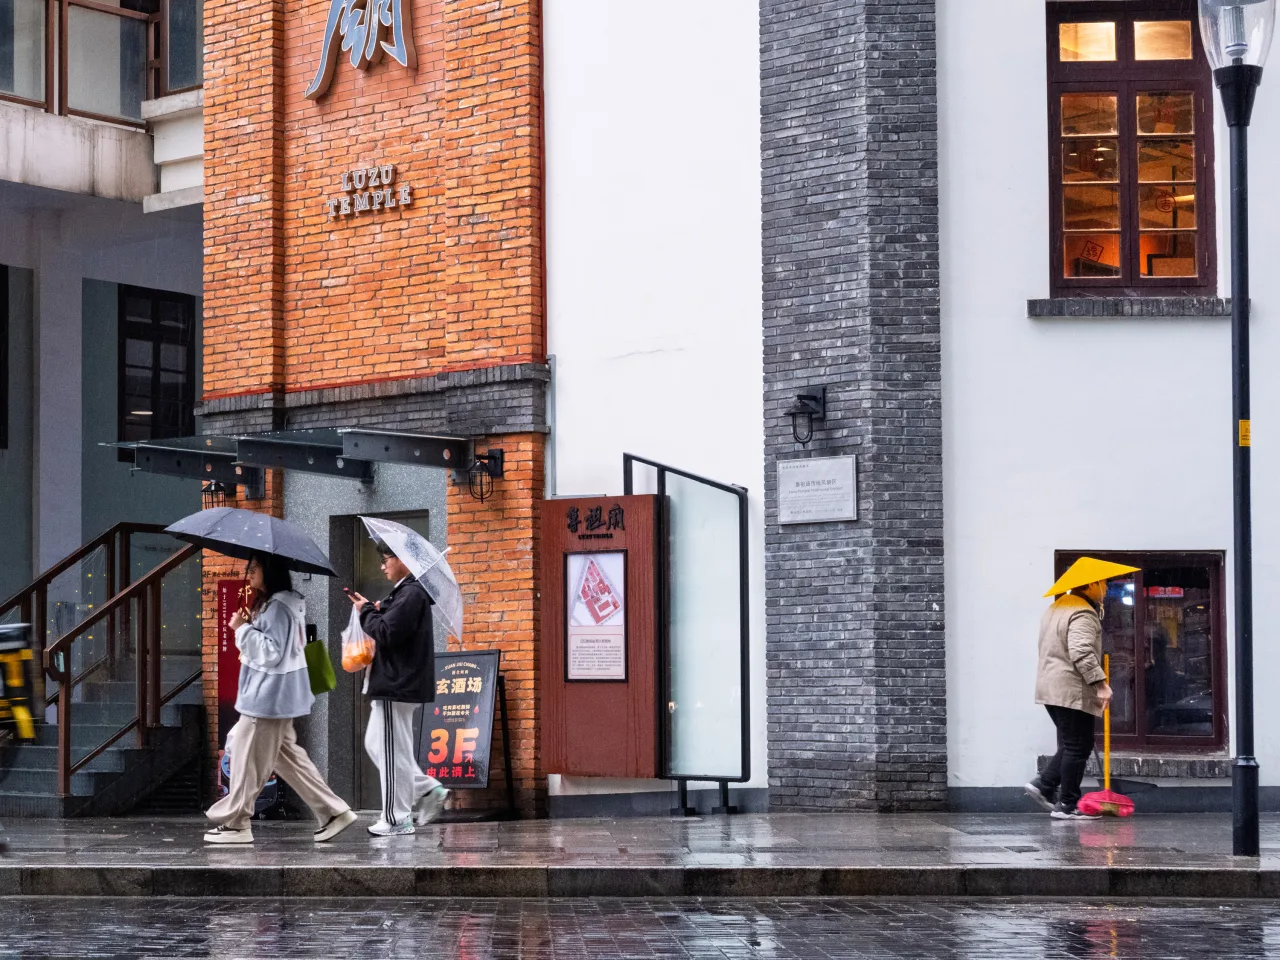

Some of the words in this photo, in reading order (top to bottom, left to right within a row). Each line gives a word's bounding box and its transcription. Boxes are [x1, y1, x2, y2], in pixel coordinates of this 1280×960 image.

[341, 164, 395, 191] LUZU
[326, 184, 412, 217] TEMPLE
[436, 677, 482, 694] 玄酒场
[428, 728, 479, 764] 3F
